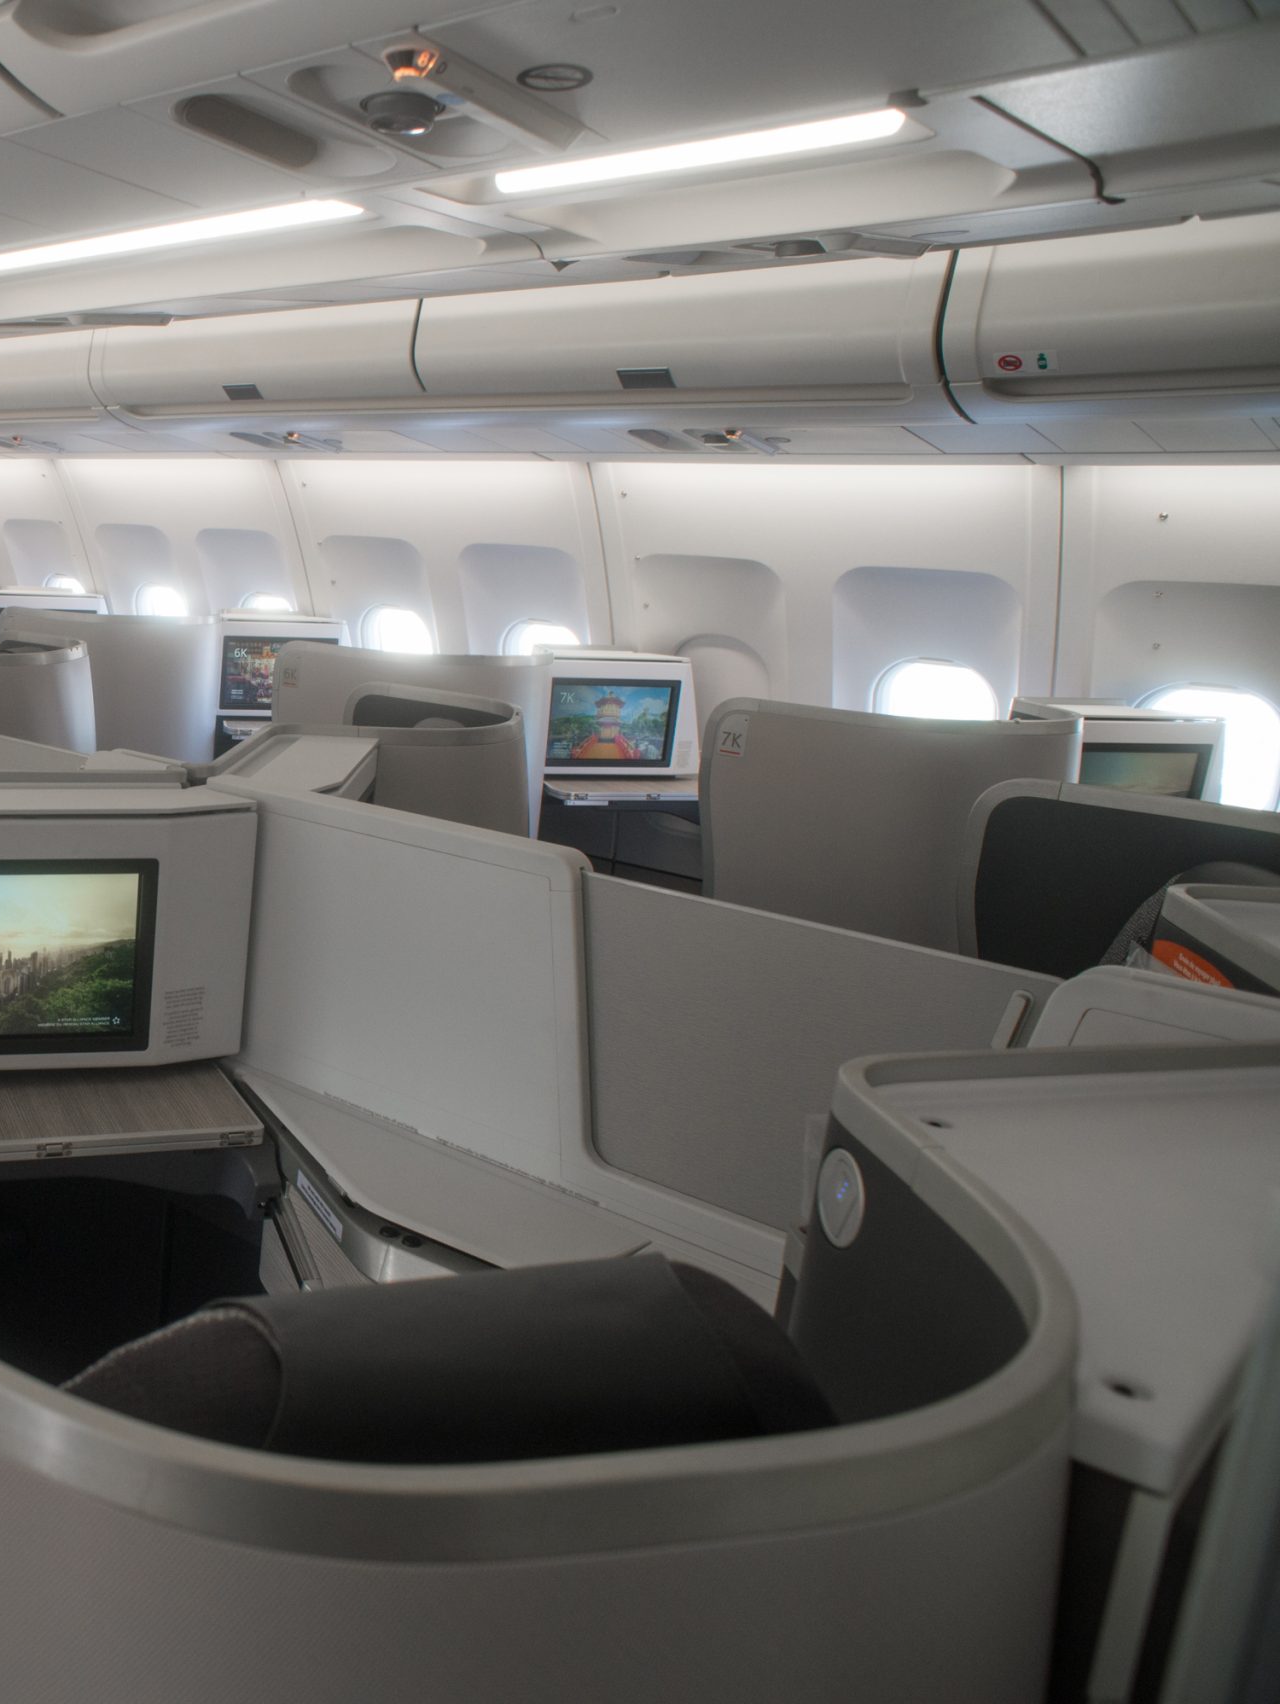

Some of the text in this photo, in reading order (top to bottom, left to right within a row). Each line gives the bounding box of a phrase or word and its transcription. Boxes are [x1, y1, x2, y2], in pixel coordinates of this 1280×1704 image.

[234, 647, 248, 658] 6K
[560, 692, 575, 704] 7K
[722, 730, 742, 748] 7K
